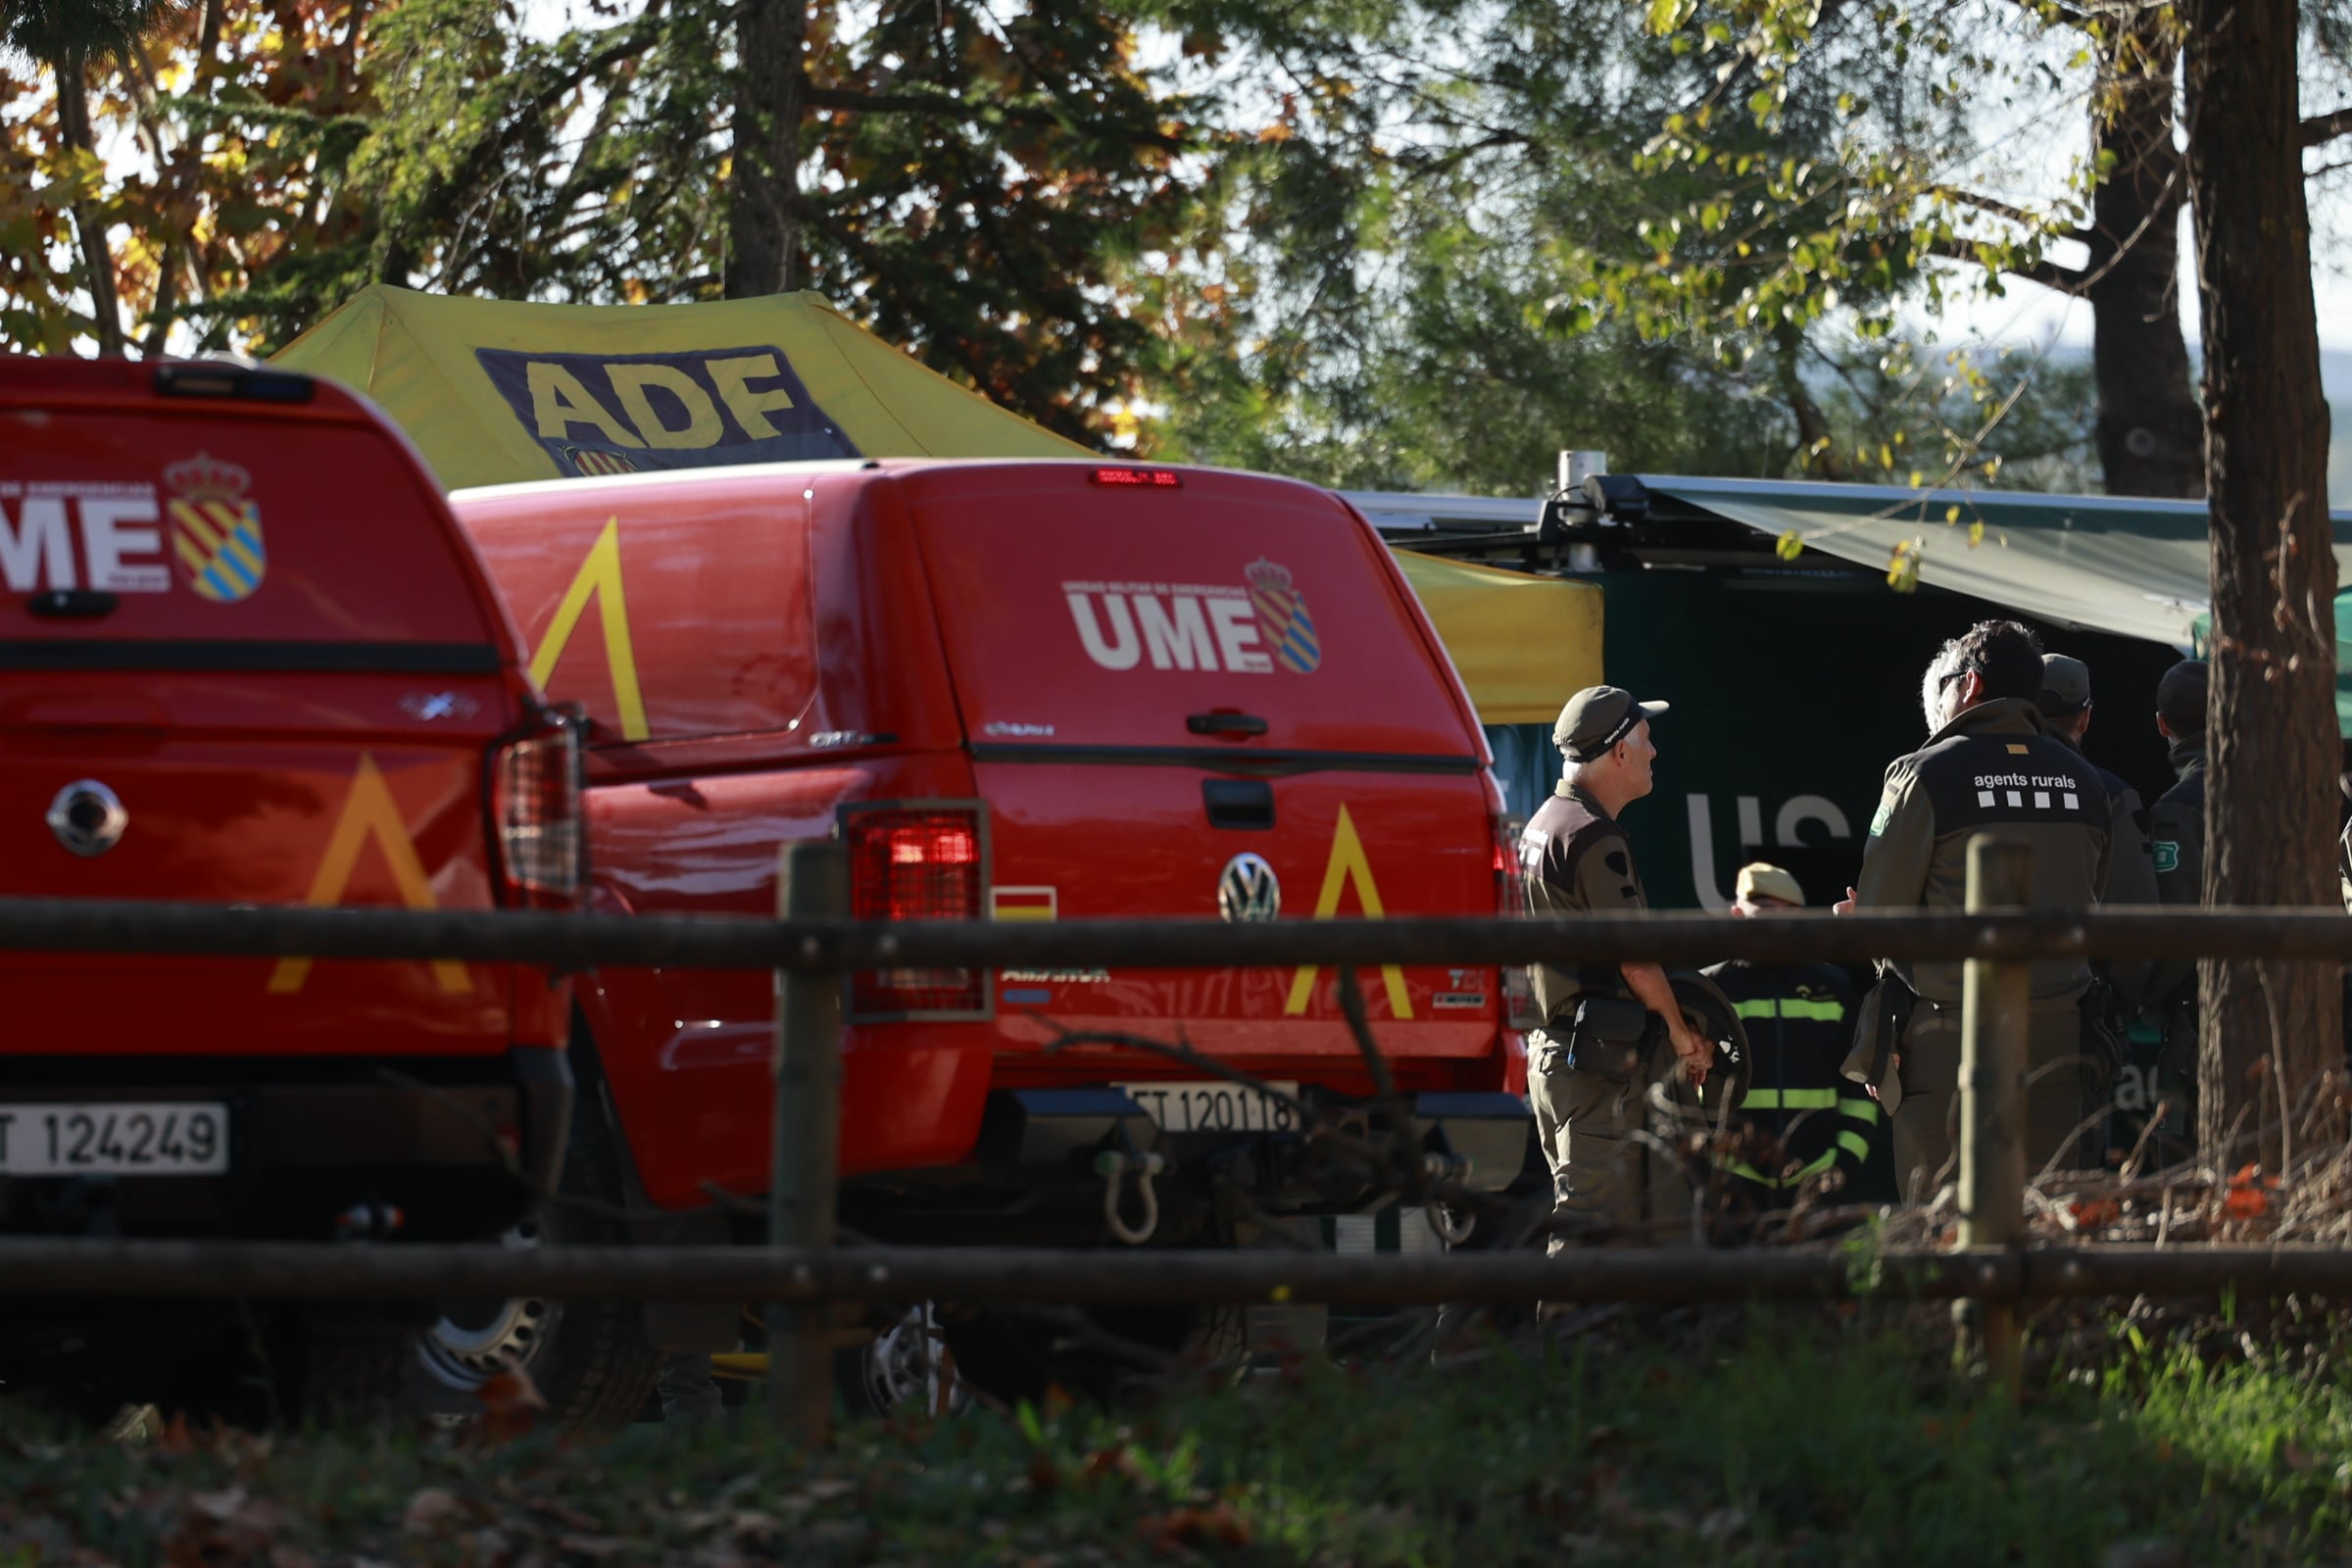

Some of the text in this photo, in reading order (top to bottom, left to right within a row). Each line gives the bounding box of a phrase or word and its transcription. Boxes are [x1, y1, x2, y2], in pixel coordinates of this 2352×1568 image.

[526, 353, 795, 450] ADF
[1066, 592, 1274, 674] UME
[1974, 772, 2077, 789] agents rurals
[45, 1112, 216, 1164] 124249
